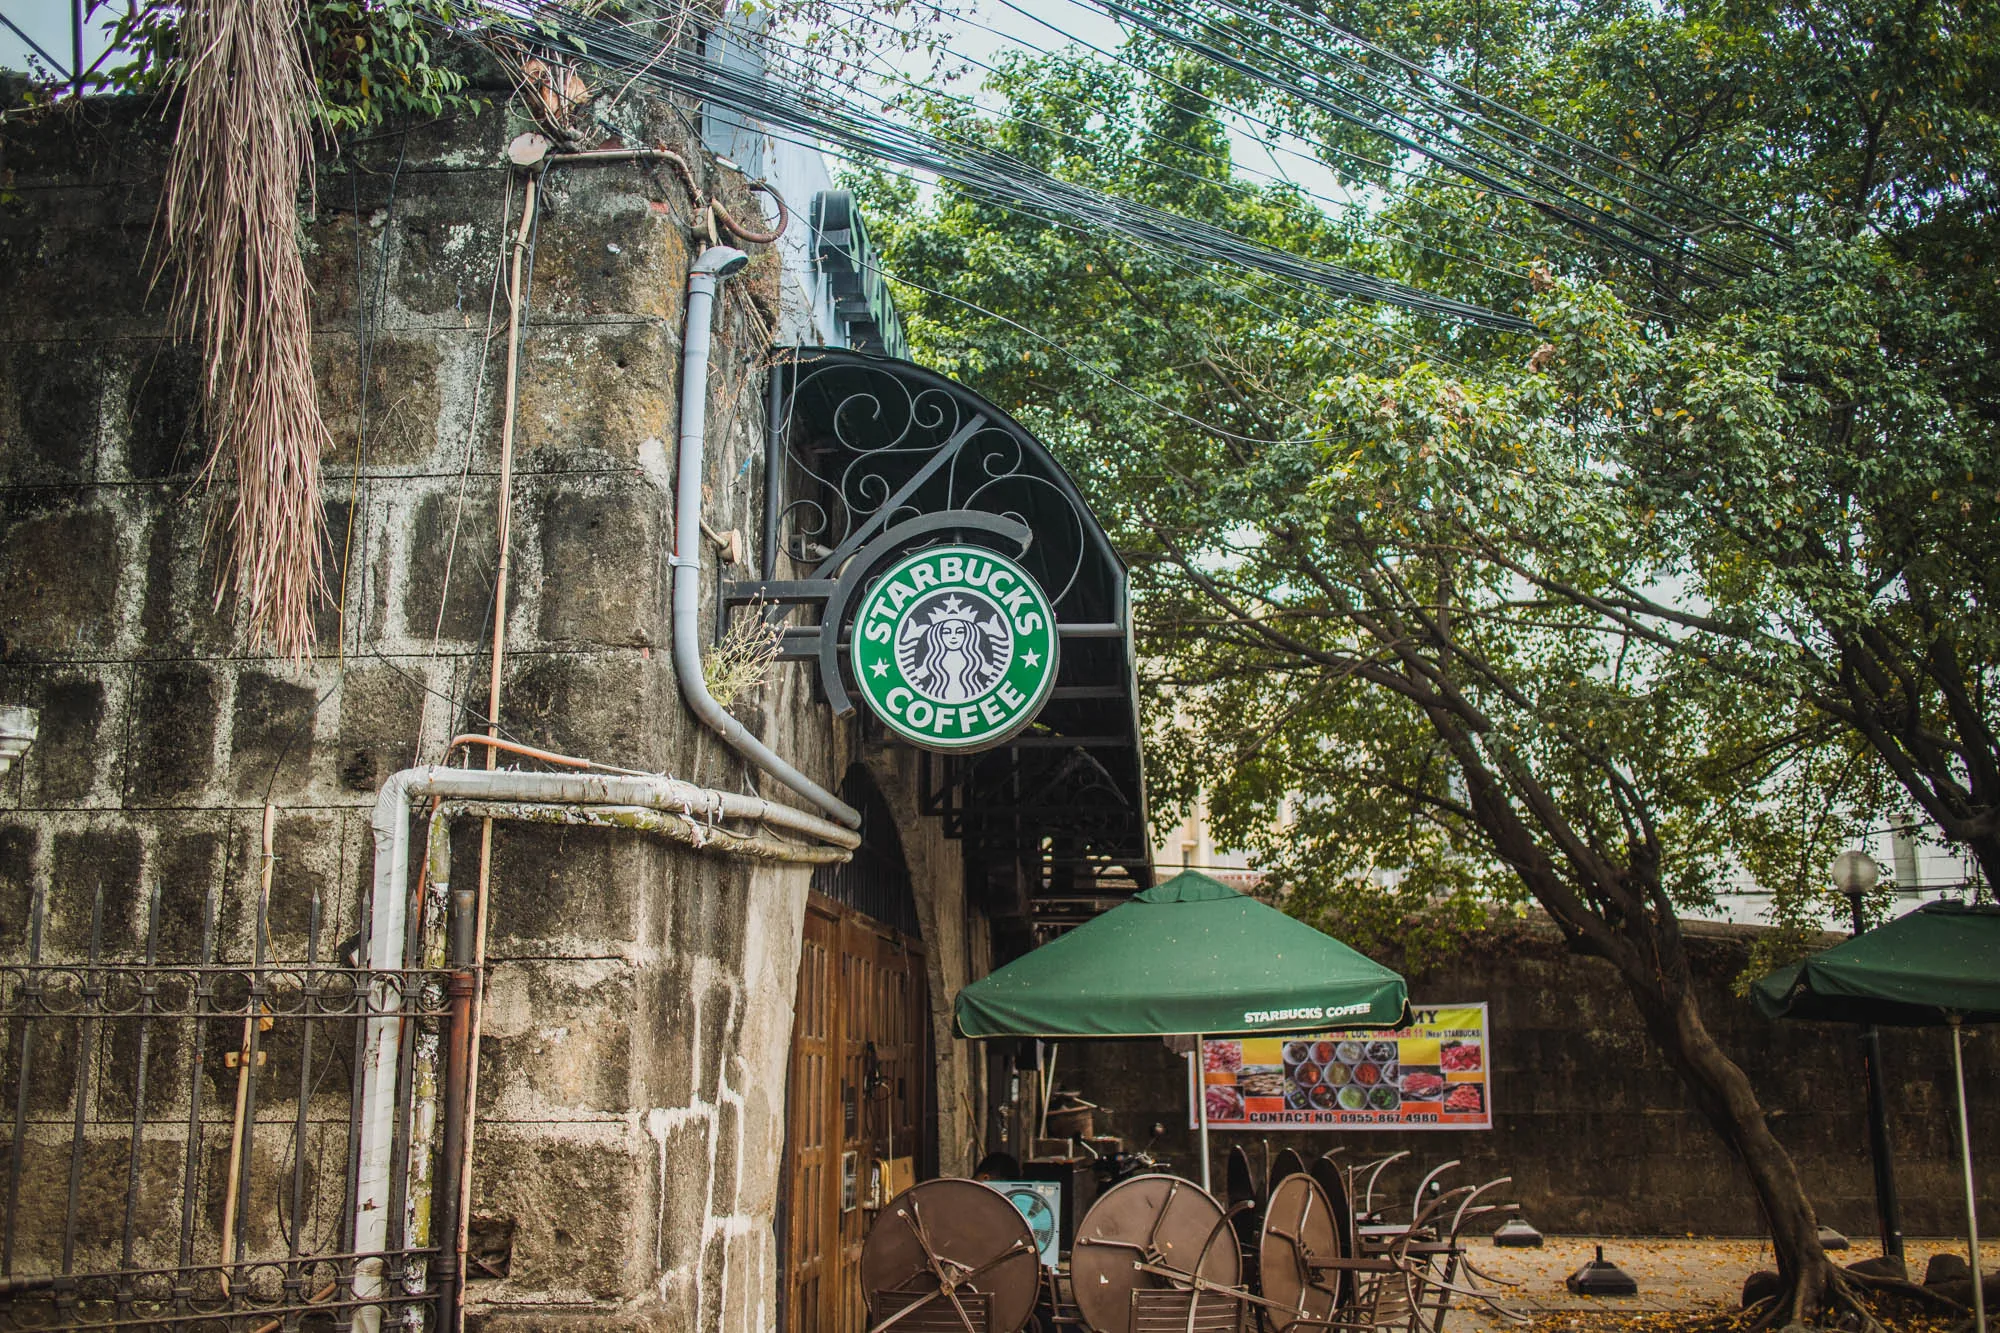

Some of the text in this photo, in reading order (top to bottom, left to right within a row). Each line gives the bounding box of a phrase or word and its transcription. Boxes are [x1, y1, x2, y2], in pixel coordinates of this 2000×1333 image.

[865, 556, 1043, 645] STARBUCKS
[885, 680, 1027, 734] COFFEE
[1244, 1002, 1371, 1024] STARBUCKS COFFEE
[1249, 1111, 1310, 1123] CONTACT
[1314, 1111, 1337, 1123] NO:
